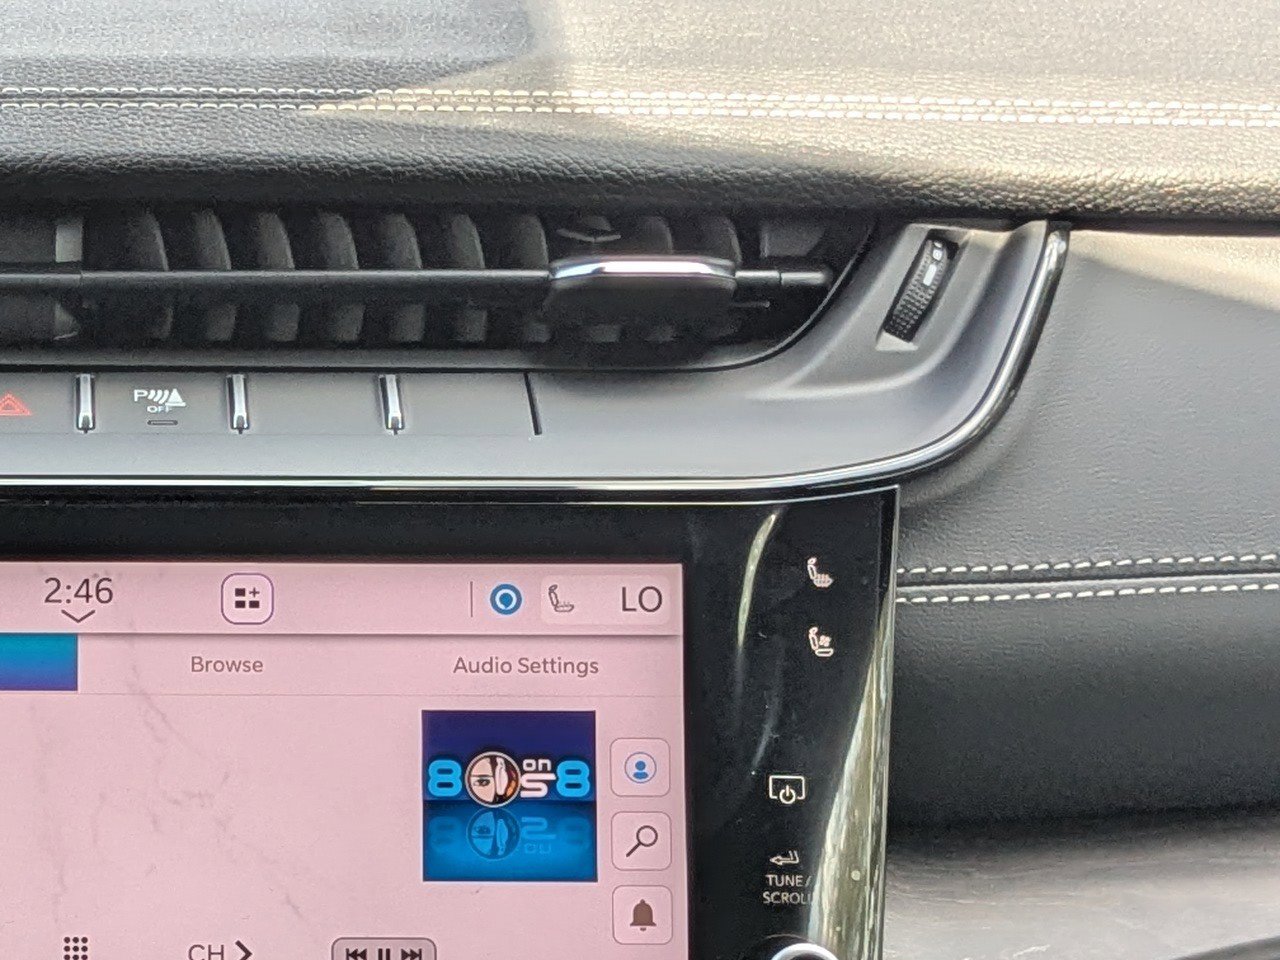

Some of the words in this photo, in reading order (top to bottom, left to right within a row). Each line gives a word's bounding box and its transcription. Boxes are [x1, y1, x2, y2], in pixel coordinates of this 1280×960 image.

[44, 577, 113, 604] 2:46
[621, 586, 663, 613] LO
[191, 656, 264, 673] Browse
[453, 657, 512, 675] Audio
[517, 657, 599, 677] Settings
[765, 874, 812, 887] TUNE/
